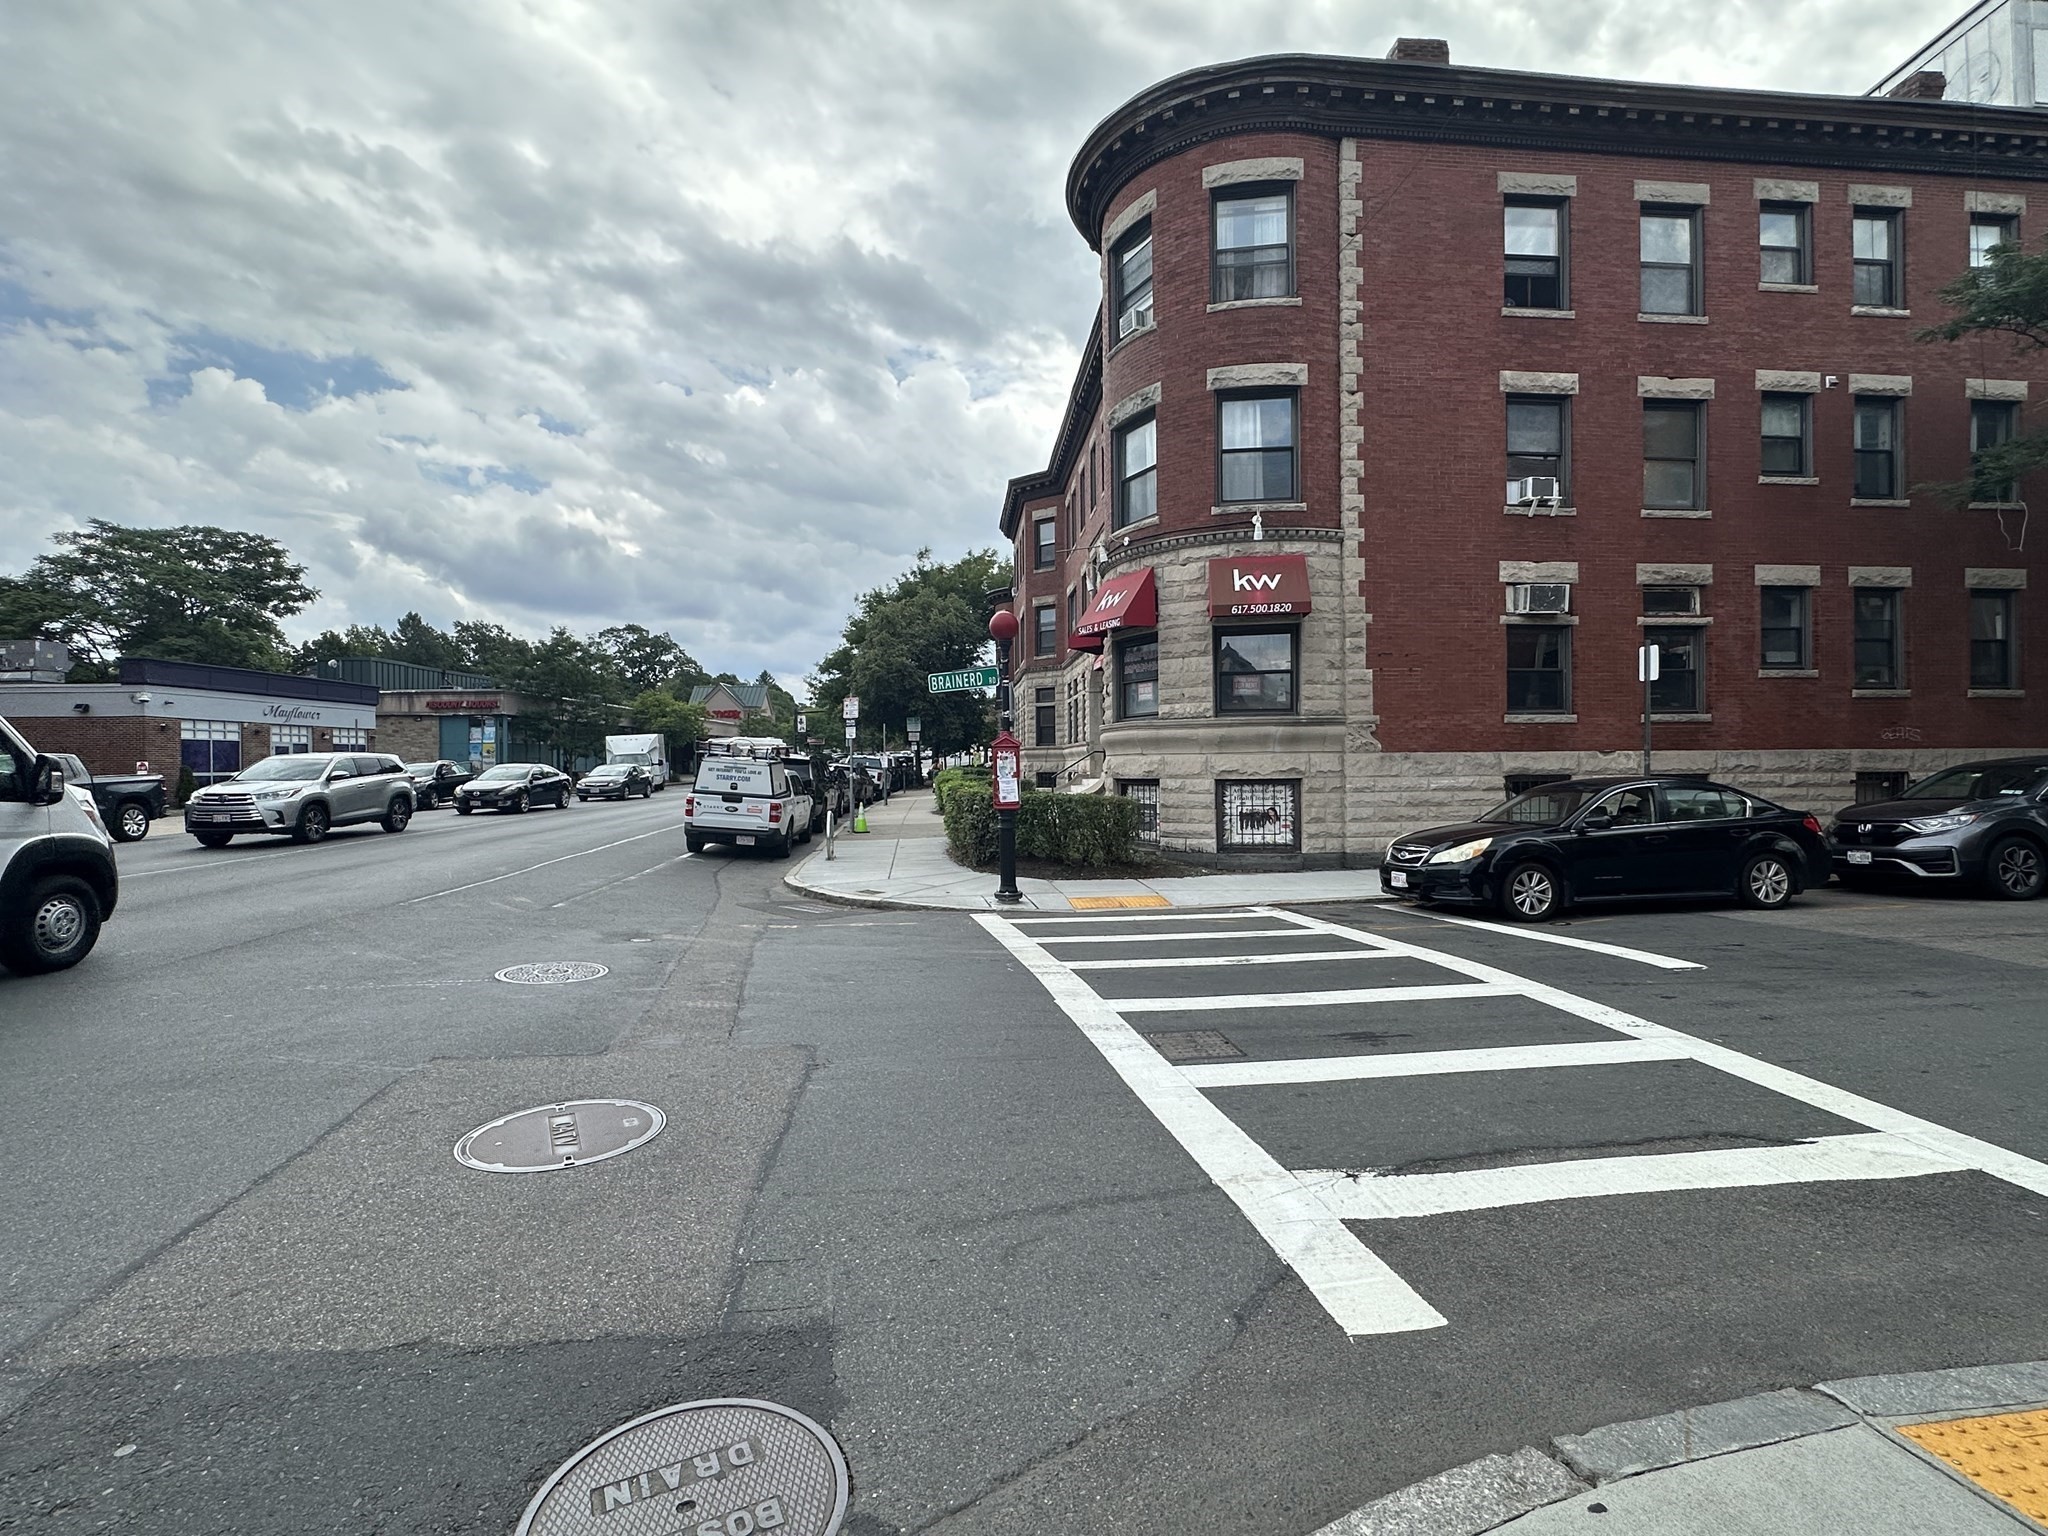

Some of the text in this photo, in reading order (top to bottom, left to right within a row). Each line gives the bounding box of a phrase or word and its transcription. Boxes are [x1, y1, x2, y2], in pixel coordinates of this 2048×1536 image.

[1233, 568, 1282, 591] kw
[1231, 603, 1292, 614] 617.500.1820
[1078, 617, 1121, 635] SALES & LEASING
[931, 672, 983, 690] BRAINERD
[262, 704, 321, 723] Mayflower
[716, 774, 751, 782] STARRY.COM
[604, 1441, 755, 1512] DRAIN
[675, 1498, 785, 1536] BOS
